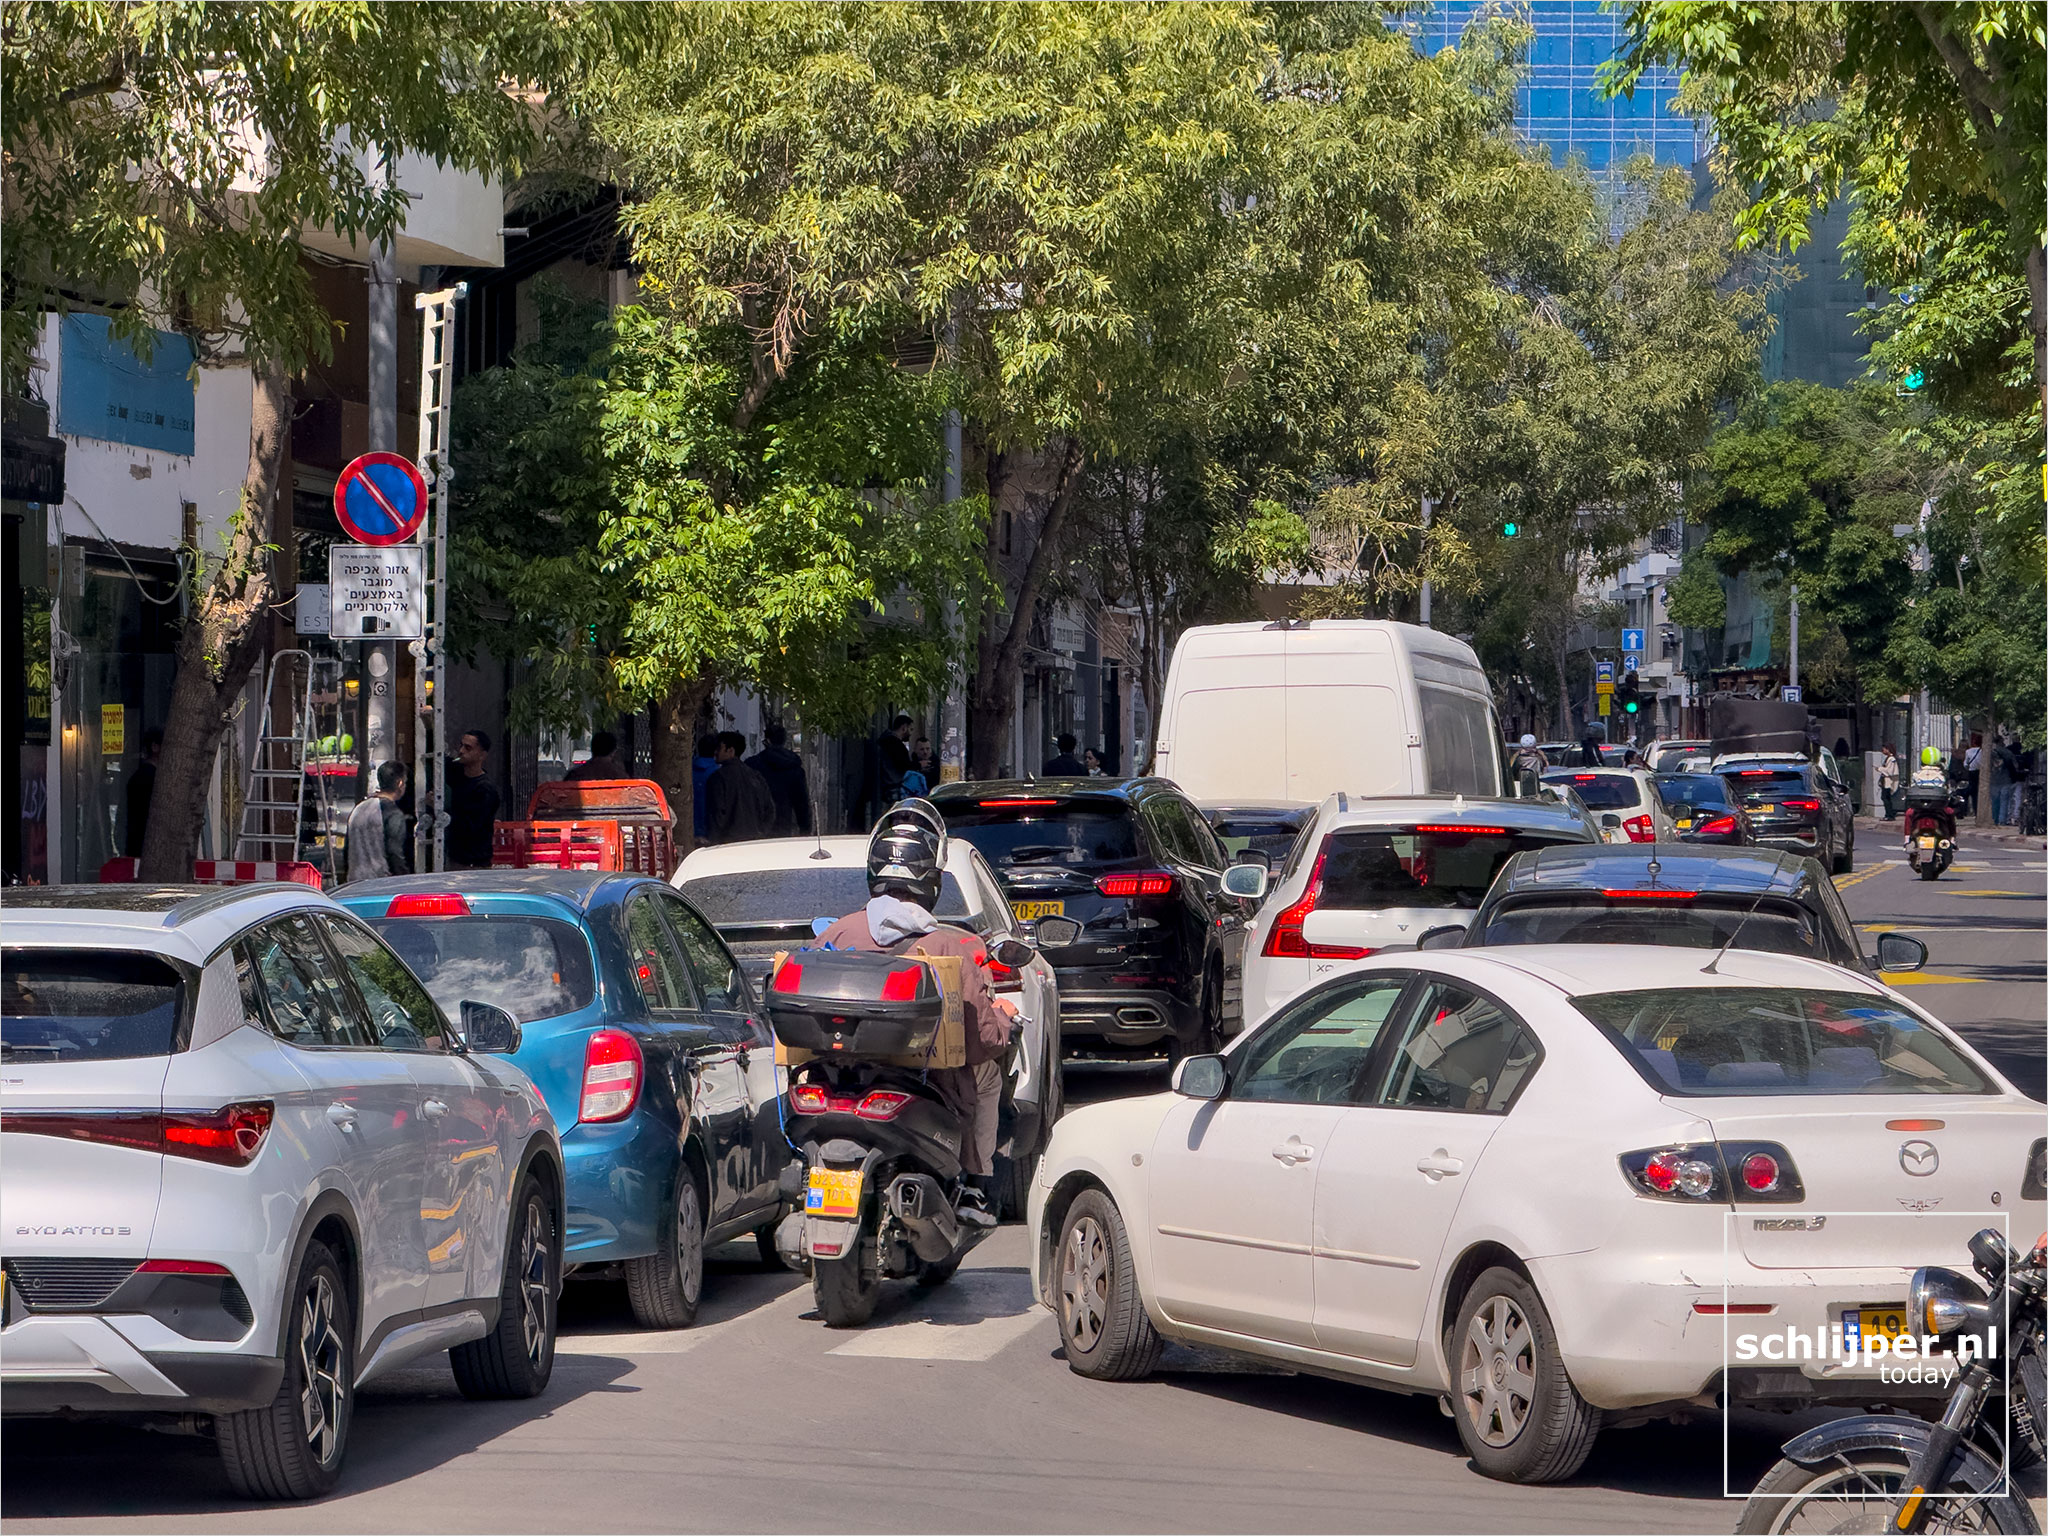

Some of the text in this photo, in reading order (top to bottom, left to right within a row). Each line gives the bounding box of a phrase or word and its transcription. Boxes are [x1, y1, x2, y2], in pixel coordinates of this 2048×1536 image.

[344, 565, 409, 575] אזור אכיפה
[360, 578, 393, 587] מוגבר
[350, 590, 404, 600] באמצעים
[344, 601, 409, 614] אלקטרוניים
[62, 1226, 114, 1236] ATTO
[118, 1226, 131, 1236] 3
